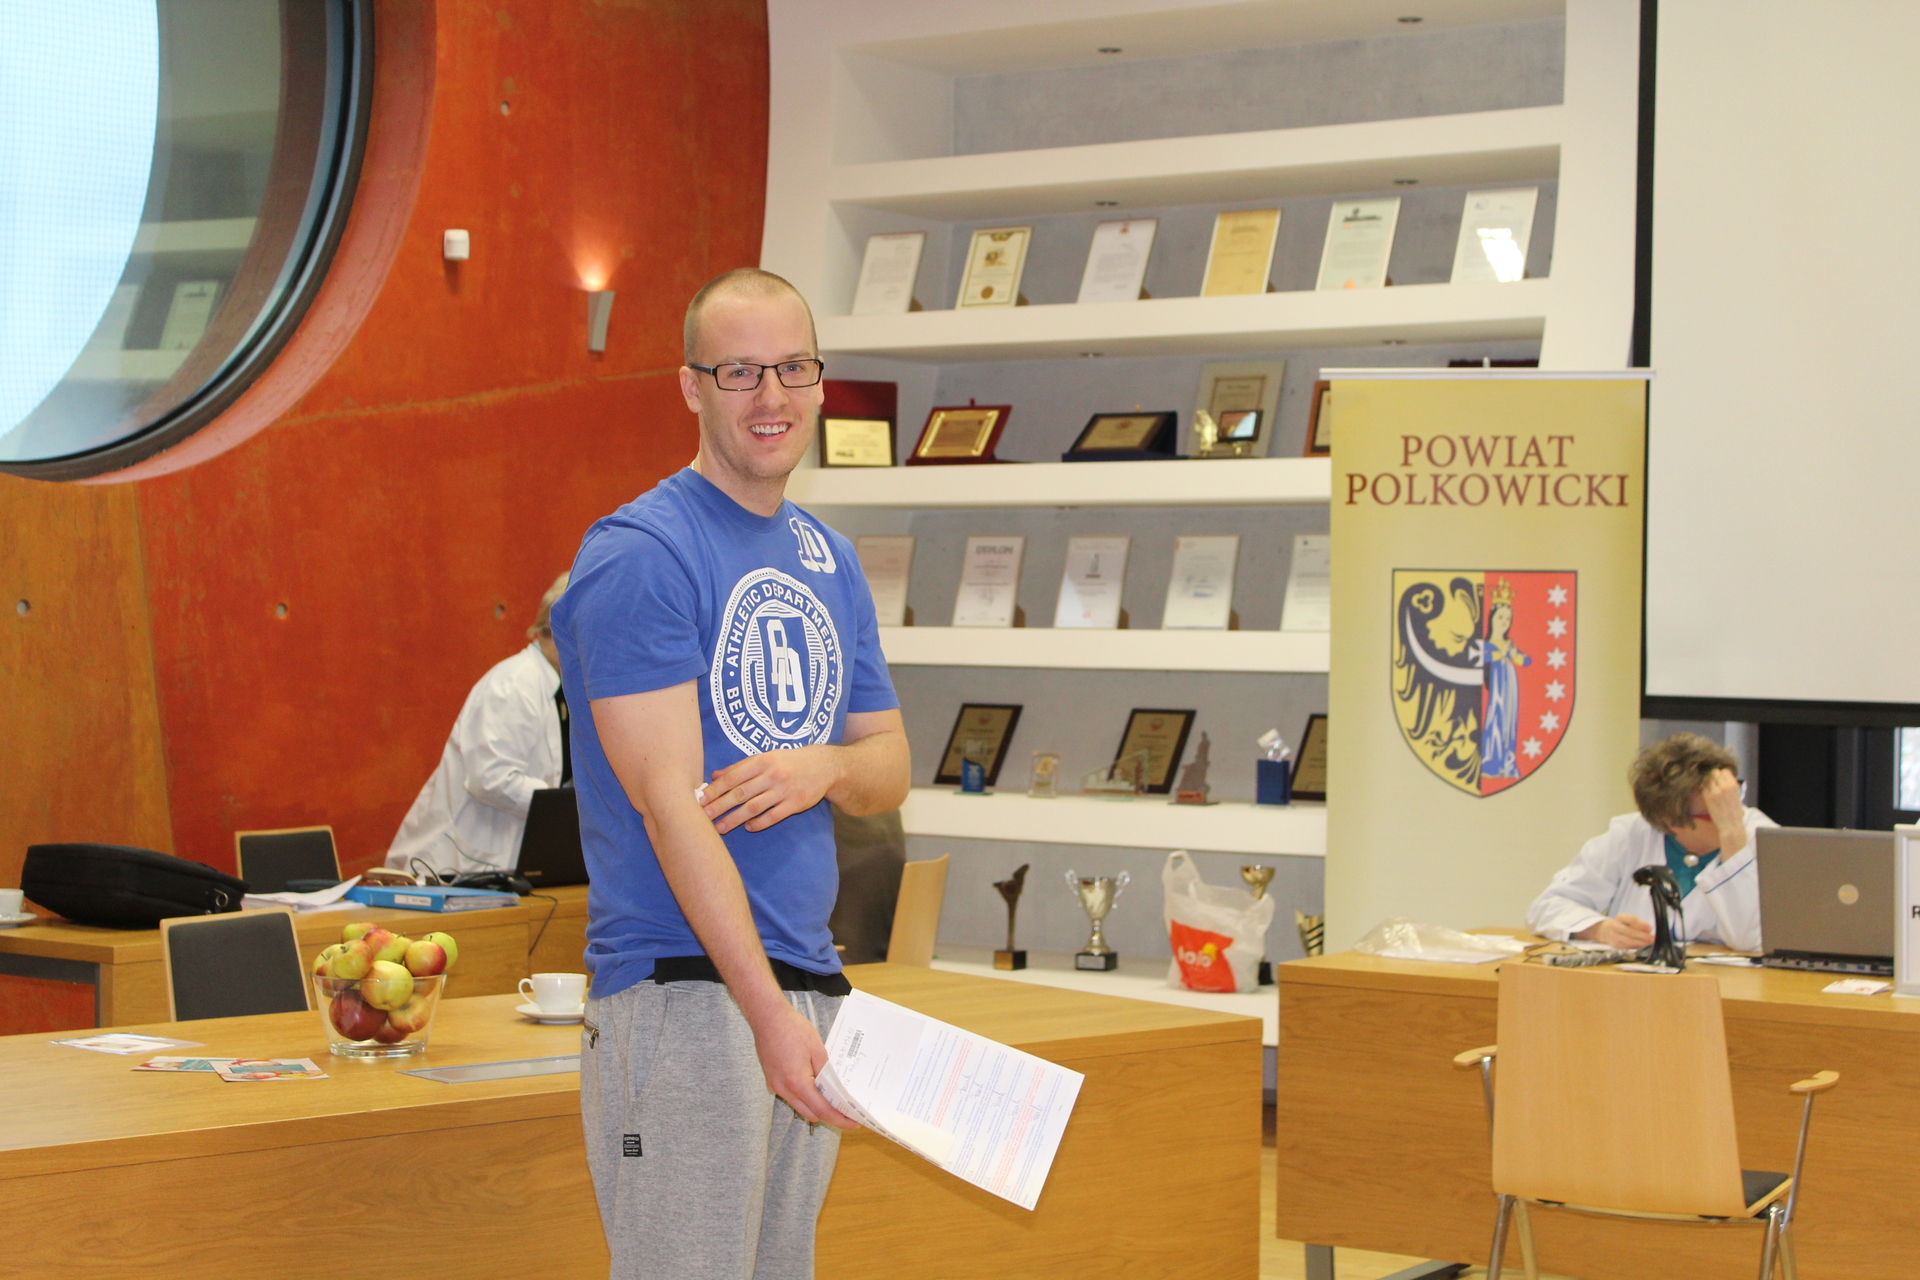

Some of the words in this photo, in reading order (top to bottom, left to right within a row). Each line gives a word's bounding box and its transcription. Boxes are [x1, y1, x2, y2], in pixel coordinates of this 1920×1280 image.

[1400, 435, 1574, 467] POWIAT
[1345, 473, 1629, 507] POLKOWICKI
[726, 589, 761, 668] ATHLETIC
[761, 582, 837, 664] DEPARTMENT
